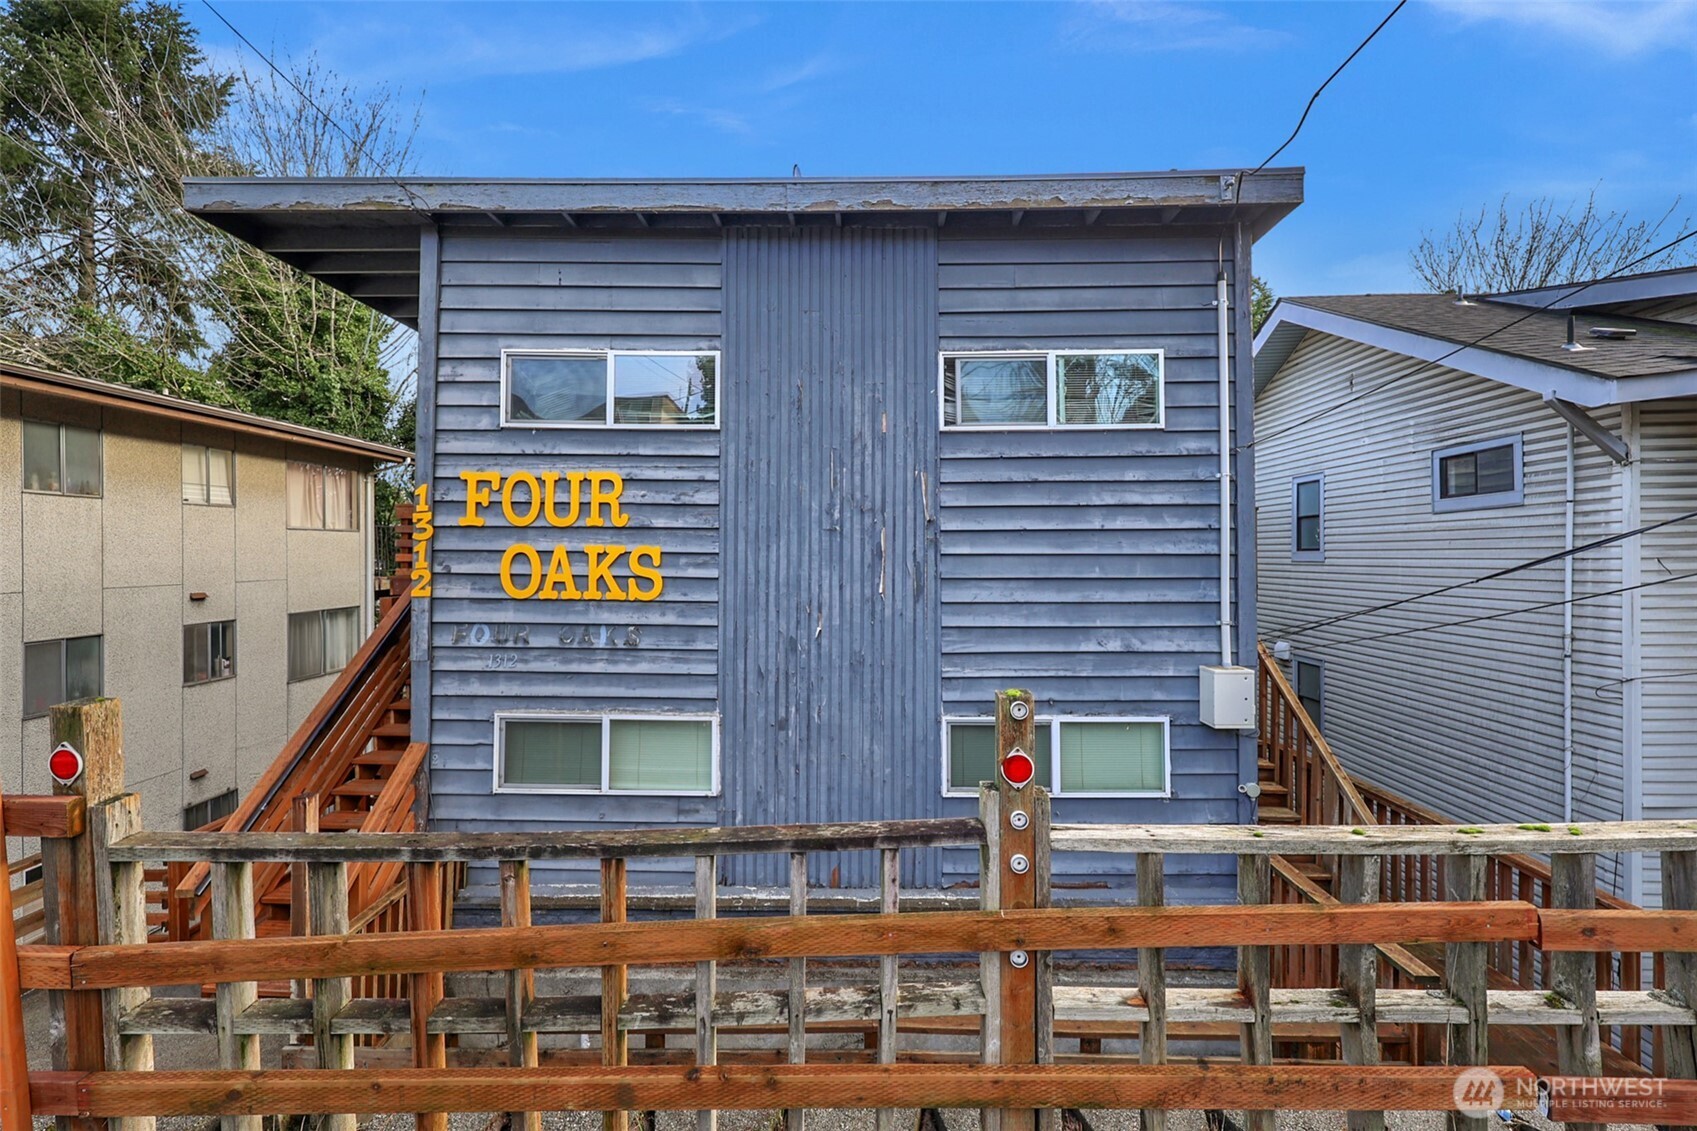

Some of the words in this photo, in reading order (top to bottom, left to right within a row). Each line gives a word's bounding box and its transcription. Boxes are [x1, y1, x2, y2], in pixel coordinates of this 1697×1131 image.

[458, 471, 630, 528] FOUR
[411, 483, 434, 597] 1312
[500, 543, 664, 602] OAKS
[452, 624, 530, 645] FOUR
[487, 654, 518, 669] 1312
